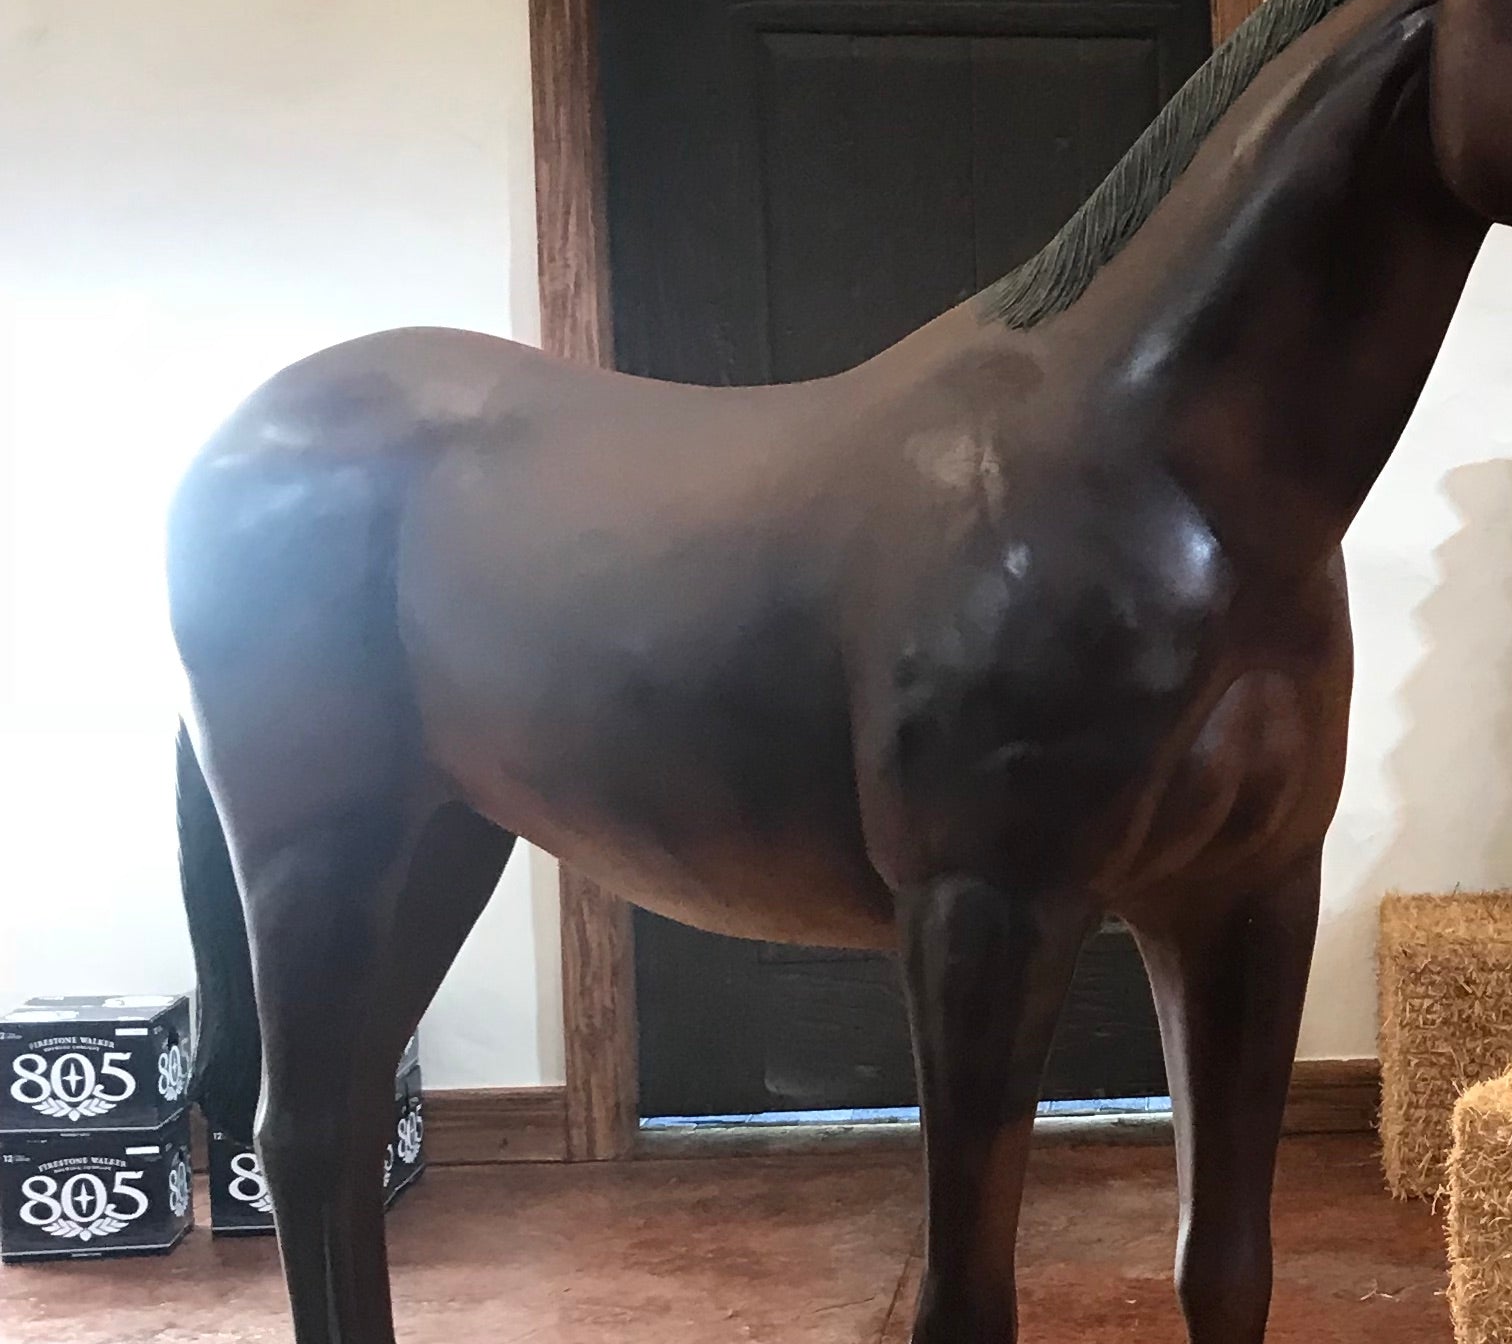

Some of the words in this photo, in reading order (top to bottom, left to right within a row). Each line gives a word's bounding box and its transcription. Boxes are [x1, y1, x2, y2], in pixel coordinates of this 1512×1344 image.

[28, 1036, 77, 1050] FIRESTONE
[80, 1036, 115, 1049] WALKER
[10, 1052, 136, 1104] 805
[38, 1156, 88, 1173] FIRESTONE
[91, 1156, 127, 1168] WALKER
[19, 1170, 149, 1226] 805
